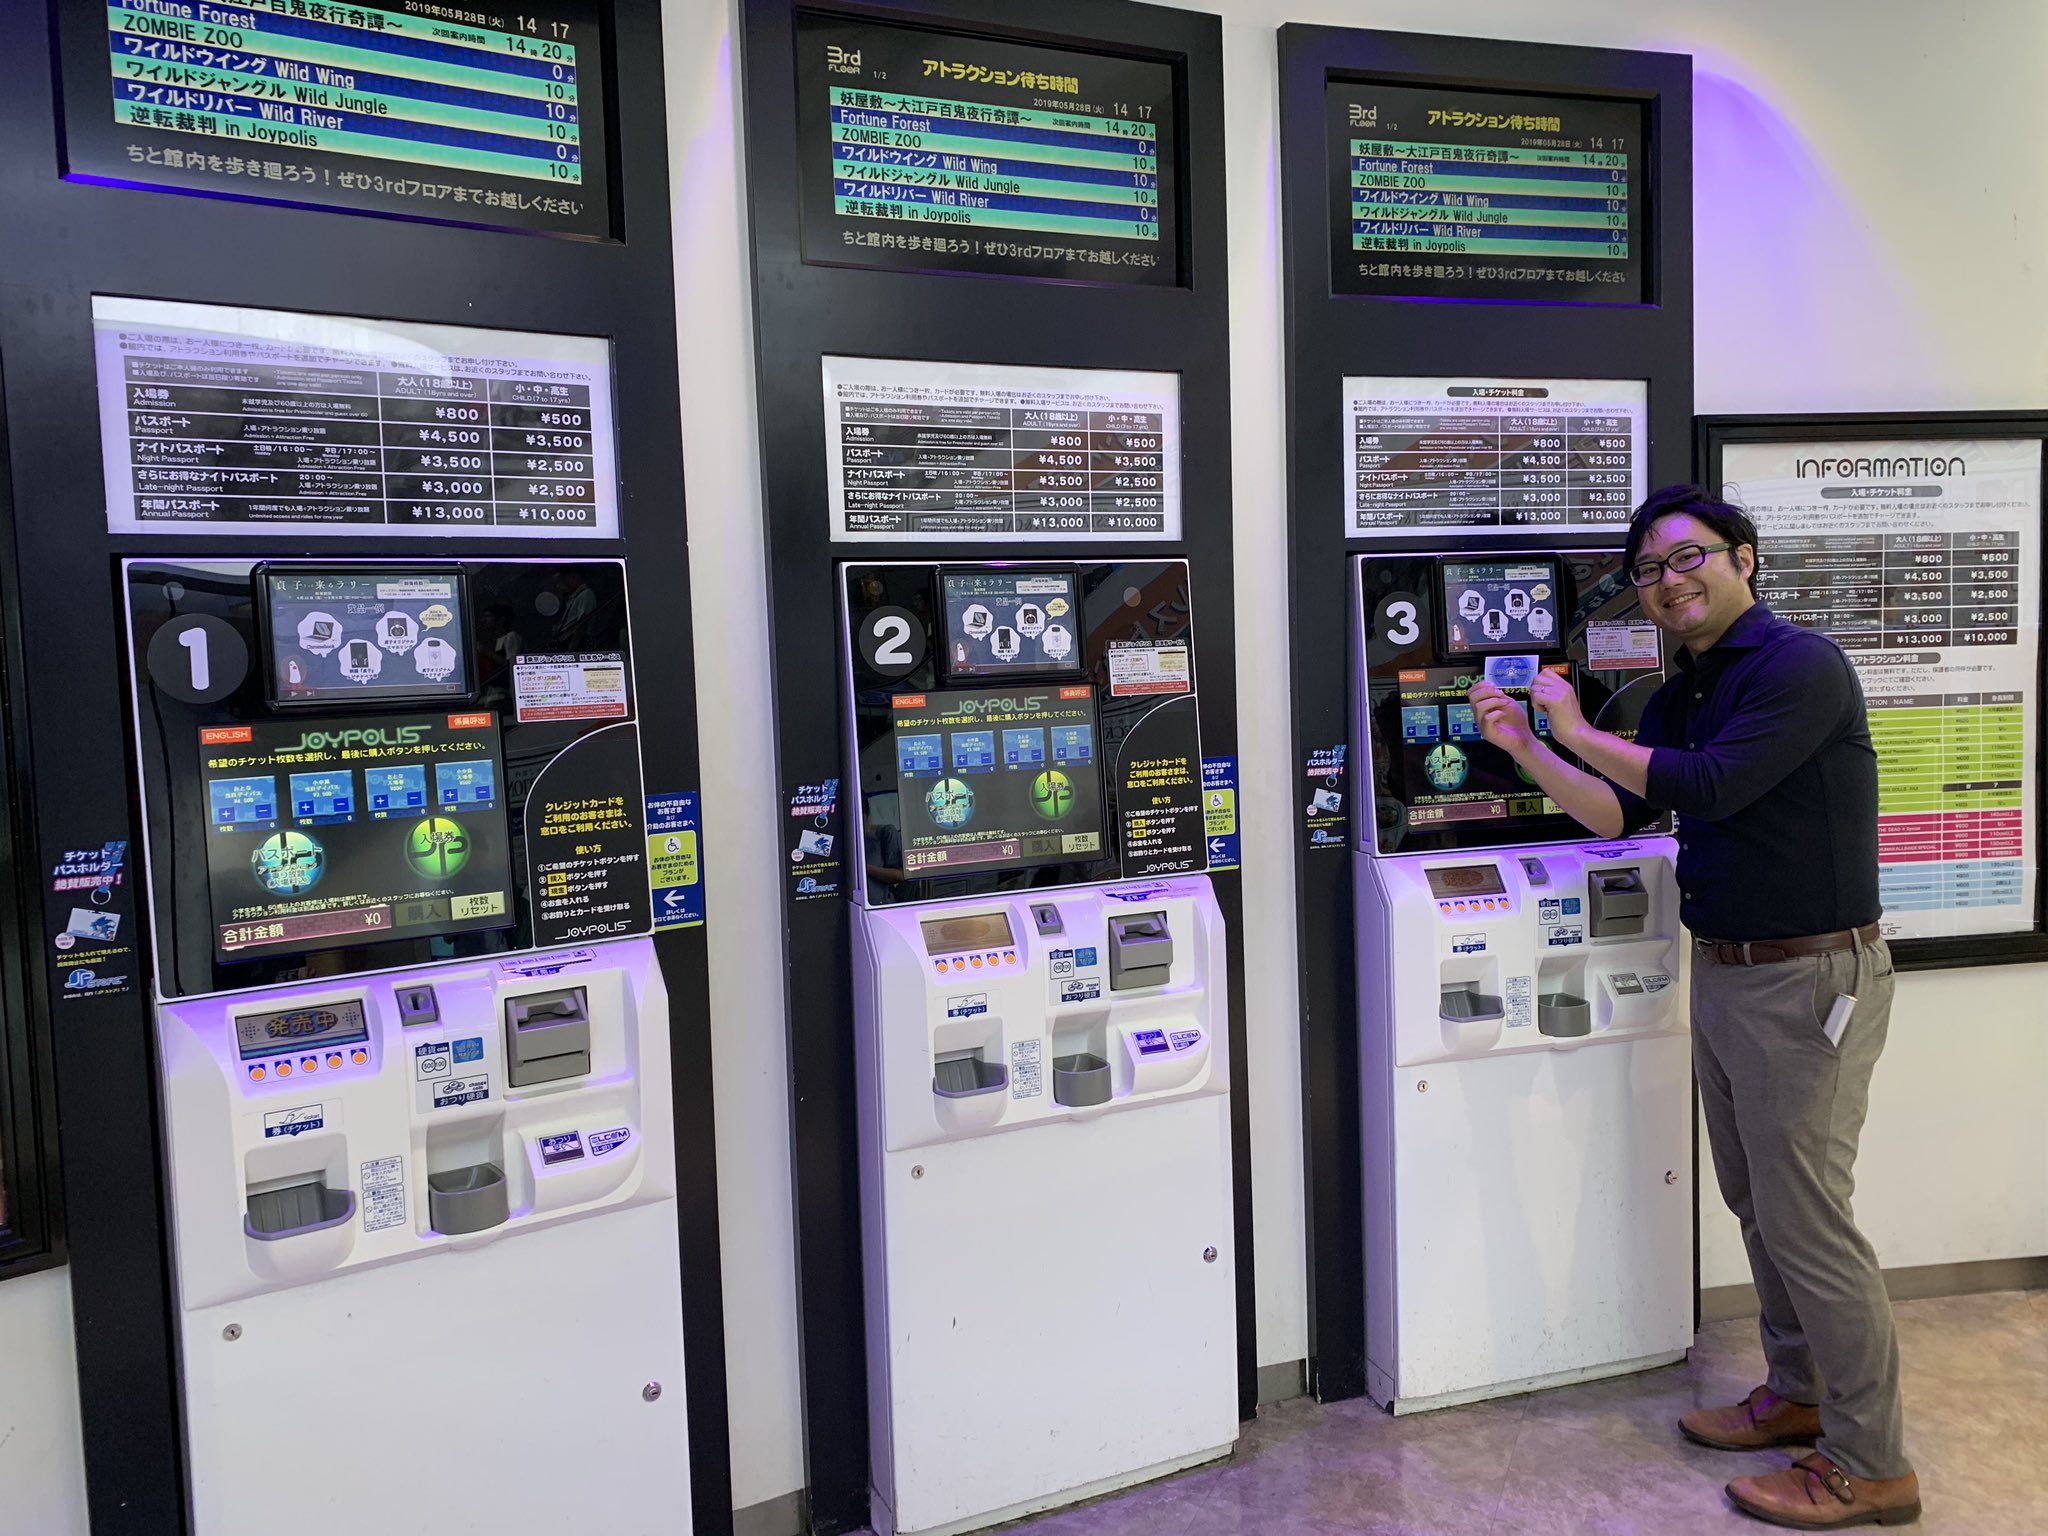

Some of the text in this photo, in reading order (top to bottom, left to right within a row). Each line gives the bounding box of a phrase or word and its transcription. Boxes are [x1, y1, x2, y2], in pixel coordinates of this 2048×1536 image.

[200, 4, 256, 30] Forest
[124, 14, 242, 48] ZOMBIE ZOO
[517, 16, 569, 39] 14 17
[432, 27, 485, 45] 次回案内時間
[124, 37, 354, 90] ワイルドウイング Wild Wing
[873, 71, 887, 80] 1/2
[922, 59, 1079, 94] アトラクション待ち時間
[126, 61, 388, 115] ワイルドジャングル Wild Jungle
[128, 84, 343, 130] ワイルドリバー Wild River
[129, 105, 318, 147] 逆転裁判 in Joypolis
[841, 110, 931, 132] Fortune Forest
[1428, 110, 1560, 132] アトラクション待ち時間
[842, 128, 922, 148] ZOMBIE ZOO
[842, 146, 998, 175] ワイルドウイング Wild Wing
[1359, 158, 1433, 174] Fortune Forest
[843, 163, 1020, 194] ワイルドジャングル Wild Jungle
[1359, 174, 1426, 188] ZOMBIE ZOO
[843, 182, 989, 209] ワイルドリバー Wild River
[1359, 190, 1489, 209] ワイルドウイング Wild Wing
[845, 200, 971, 224] 逆転裁判 in Joypolis
[1360, 206, 1508, 224] ワイルドジャングル Wild Jungle
[1360, 222, 1482, 238] ワイルドリバー Wild River
[1361, 236, 1466, 254] 逆転裁判 Joypolis
[134, 388, 169, 399] 入場券
[133, 399, 176, 407] Admission
[135, 416, 190, 427] パスポート
[435, 407, 581, 425] ¥800 ¥500
[135, 426, 173, 434] Passport
[419, 429, 583, 448] ¥4,500 ¥3,500
[1051, 436, 1156, 448] ¥800 ¥500
[1533, 439, 1626, 448] ¥800 ¥500
[137, 442, 224, 454] ナイトパスポート
[847, 449, 883, 457] パスポート
[137, 455, 199, 464] Night Passport
[420, 455, 584, 473] ¥3,500 ¥2,500
[1039, 454, 1156, 468] ¥4,500 ¥3,500
[1359, 455, 1390, 463] パスポート
[1523, 455, 1626, 466] ¥4,500 ¥3,500
[1797, 456, 1966, 478] INFORMATION
[137, 470, 278, 483] さらにお得なナイトパスポート
[848, 470, 905, 479] ナイトパスポート
[1523, 474, 1626, 484] ¥3,500 ¥2,500
[186, 484, 223, 493] Passport
[1040, 476, 1156, 488] ¥3,500 ¥2,500
[422, 481, 585, 498] ¥3,000 ¥2,500
[1040, 497, 1156, 508] ¥3,000 ¥2,500
[1523, 492, 1626, 503] ¥3,000 ¥2,500
[141, 500, 220, 511] 年間パスポート
[141, 509, 209, 519] Annual Passport
[412, 506, 586, 522] ¥13,000 ¥10,000
[849, 515, 901, 523] 年間パスポート
[1516, 510, 1626, 522] ¥13,000 ¥10,000
[1032, 517, 1157, 529] ¥13,000 ¥10,000
[1915, 552, 2009, 564] ¥800 ¥500
[1904, 569, 2008, 582] ¥4,500 ¥3,500
[1904, 589, 2008, 601] ¥3,500 ¥2,500
[1386, 601, 1420, 644] 3
[1904, 611, 2008, 624] ¥3,000 ¥2,500
[873, 616, 912, 665] 2
[1897, 632, 2008, 645] ¥13,000 ¥10,000
[178, 627, 210, 690] 1
[895, 696, 1048, 715] ENGLISH JOYPOLIS
[206, 725, 432, 752] ENGLISH JOYPOLIS
[1130, 758, 1187, 769] クレジットカードを
[798, 784, 828, 794] チケット
[545, 797, 624, 811] クレジットカードを
[791, 794, 836, 804] パスホルダー
[545, 808, 627, 824] ご利用のお客さまは、
[1409, 802, 1536, 820] 合計金額 購入
[540, 821, 632, 836] 窓口をご利用ください。
[420, 831, 455, 844] 入場券
[65, 849, 110, 862] チケット
[252, 846, 323, 862] パスポート
[575, 844, 601, 855] 使い方
[906, 851, 947, 865] 合計金額
[54, 862, 123, 875] パスホルダー
[1138, 860, 1193, 874] JOYPOLIS
[469, 896, 489, 905] 枚数
[408, 905, 441, 919] 購入
[460, 904, 498, 916] リセット
[224, 913, 381, 944] 合計金額 ¥0
[555, 920, 632, 940] JOYPOLIS
[267, 1011, 339, 1037] 発売中
